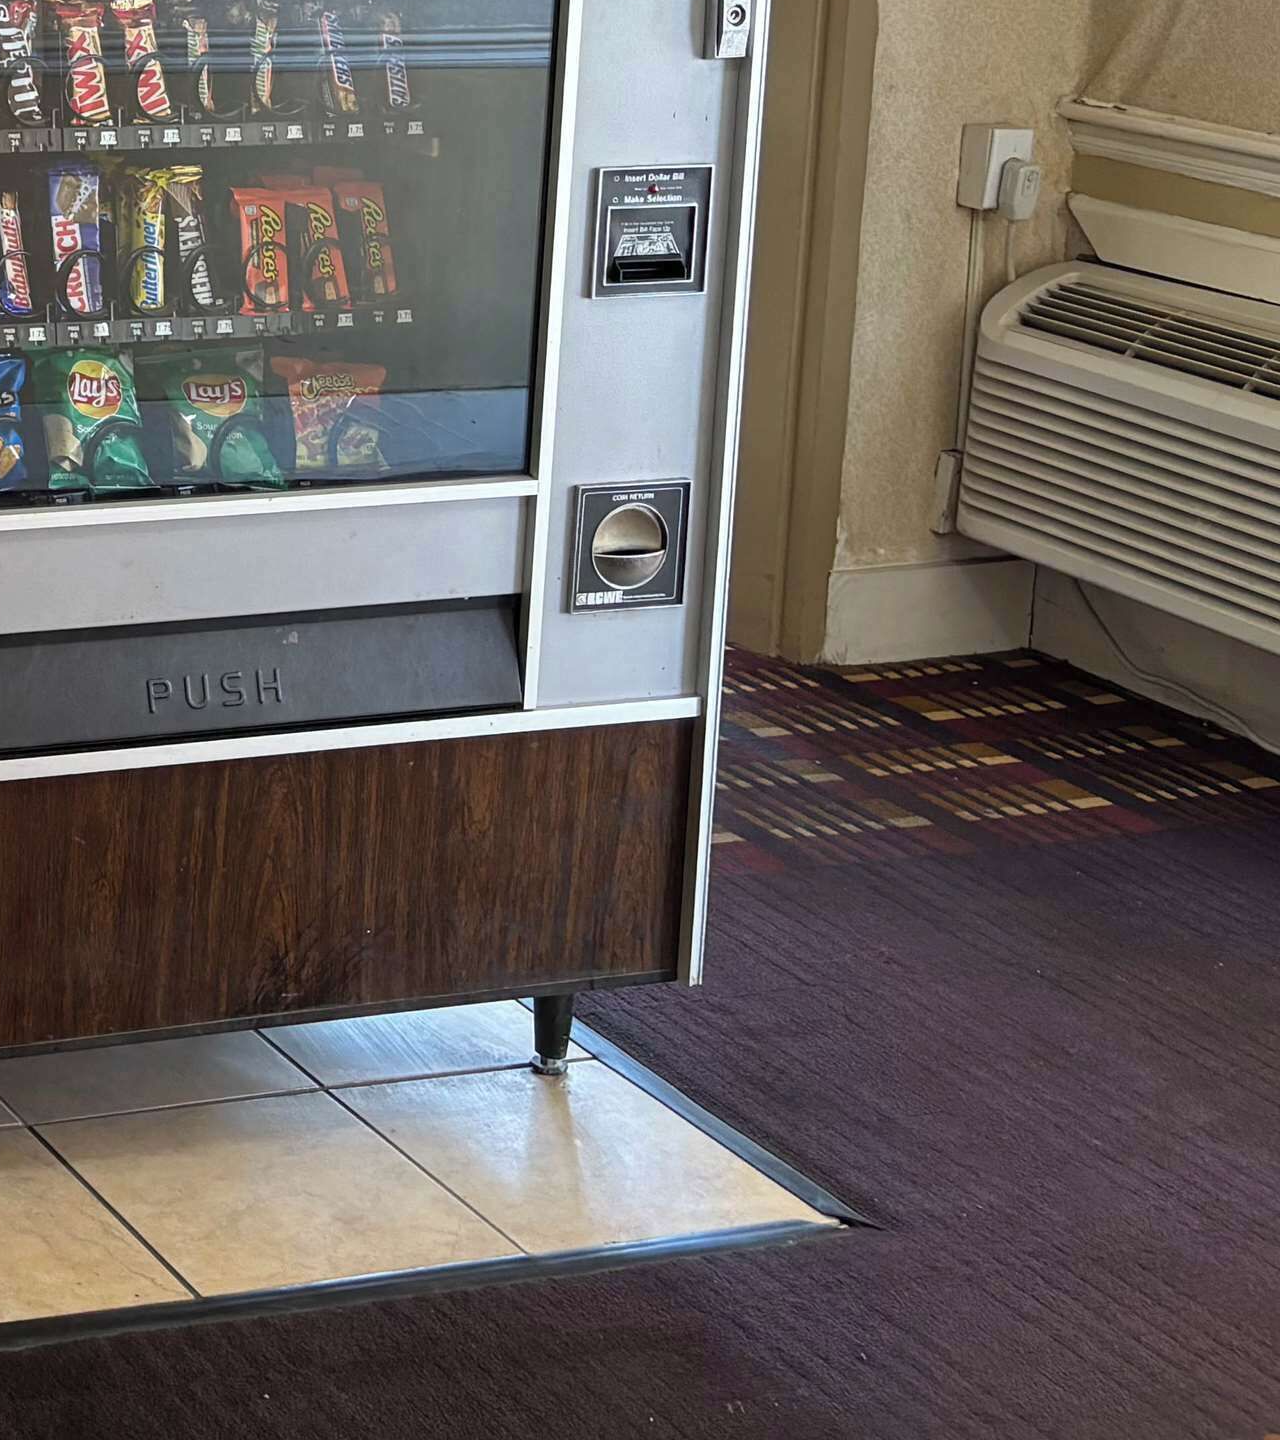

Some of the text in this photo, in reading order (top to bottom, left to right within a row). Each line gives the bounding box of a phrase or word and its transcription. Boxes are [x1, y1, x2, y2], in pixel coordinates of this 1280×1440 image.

[624, 172, 685, 182] Insert Dollar Bill
[624, 194, 683, 203] Make Selection
[72, 372, 121, 407] Lay's
[189, 380, 243, 403] Lay's
[300, 374, 355, 401] Cheetos
[629, 492, 655, 500] RETURN
[146, 667, 283, 714] PUSH
